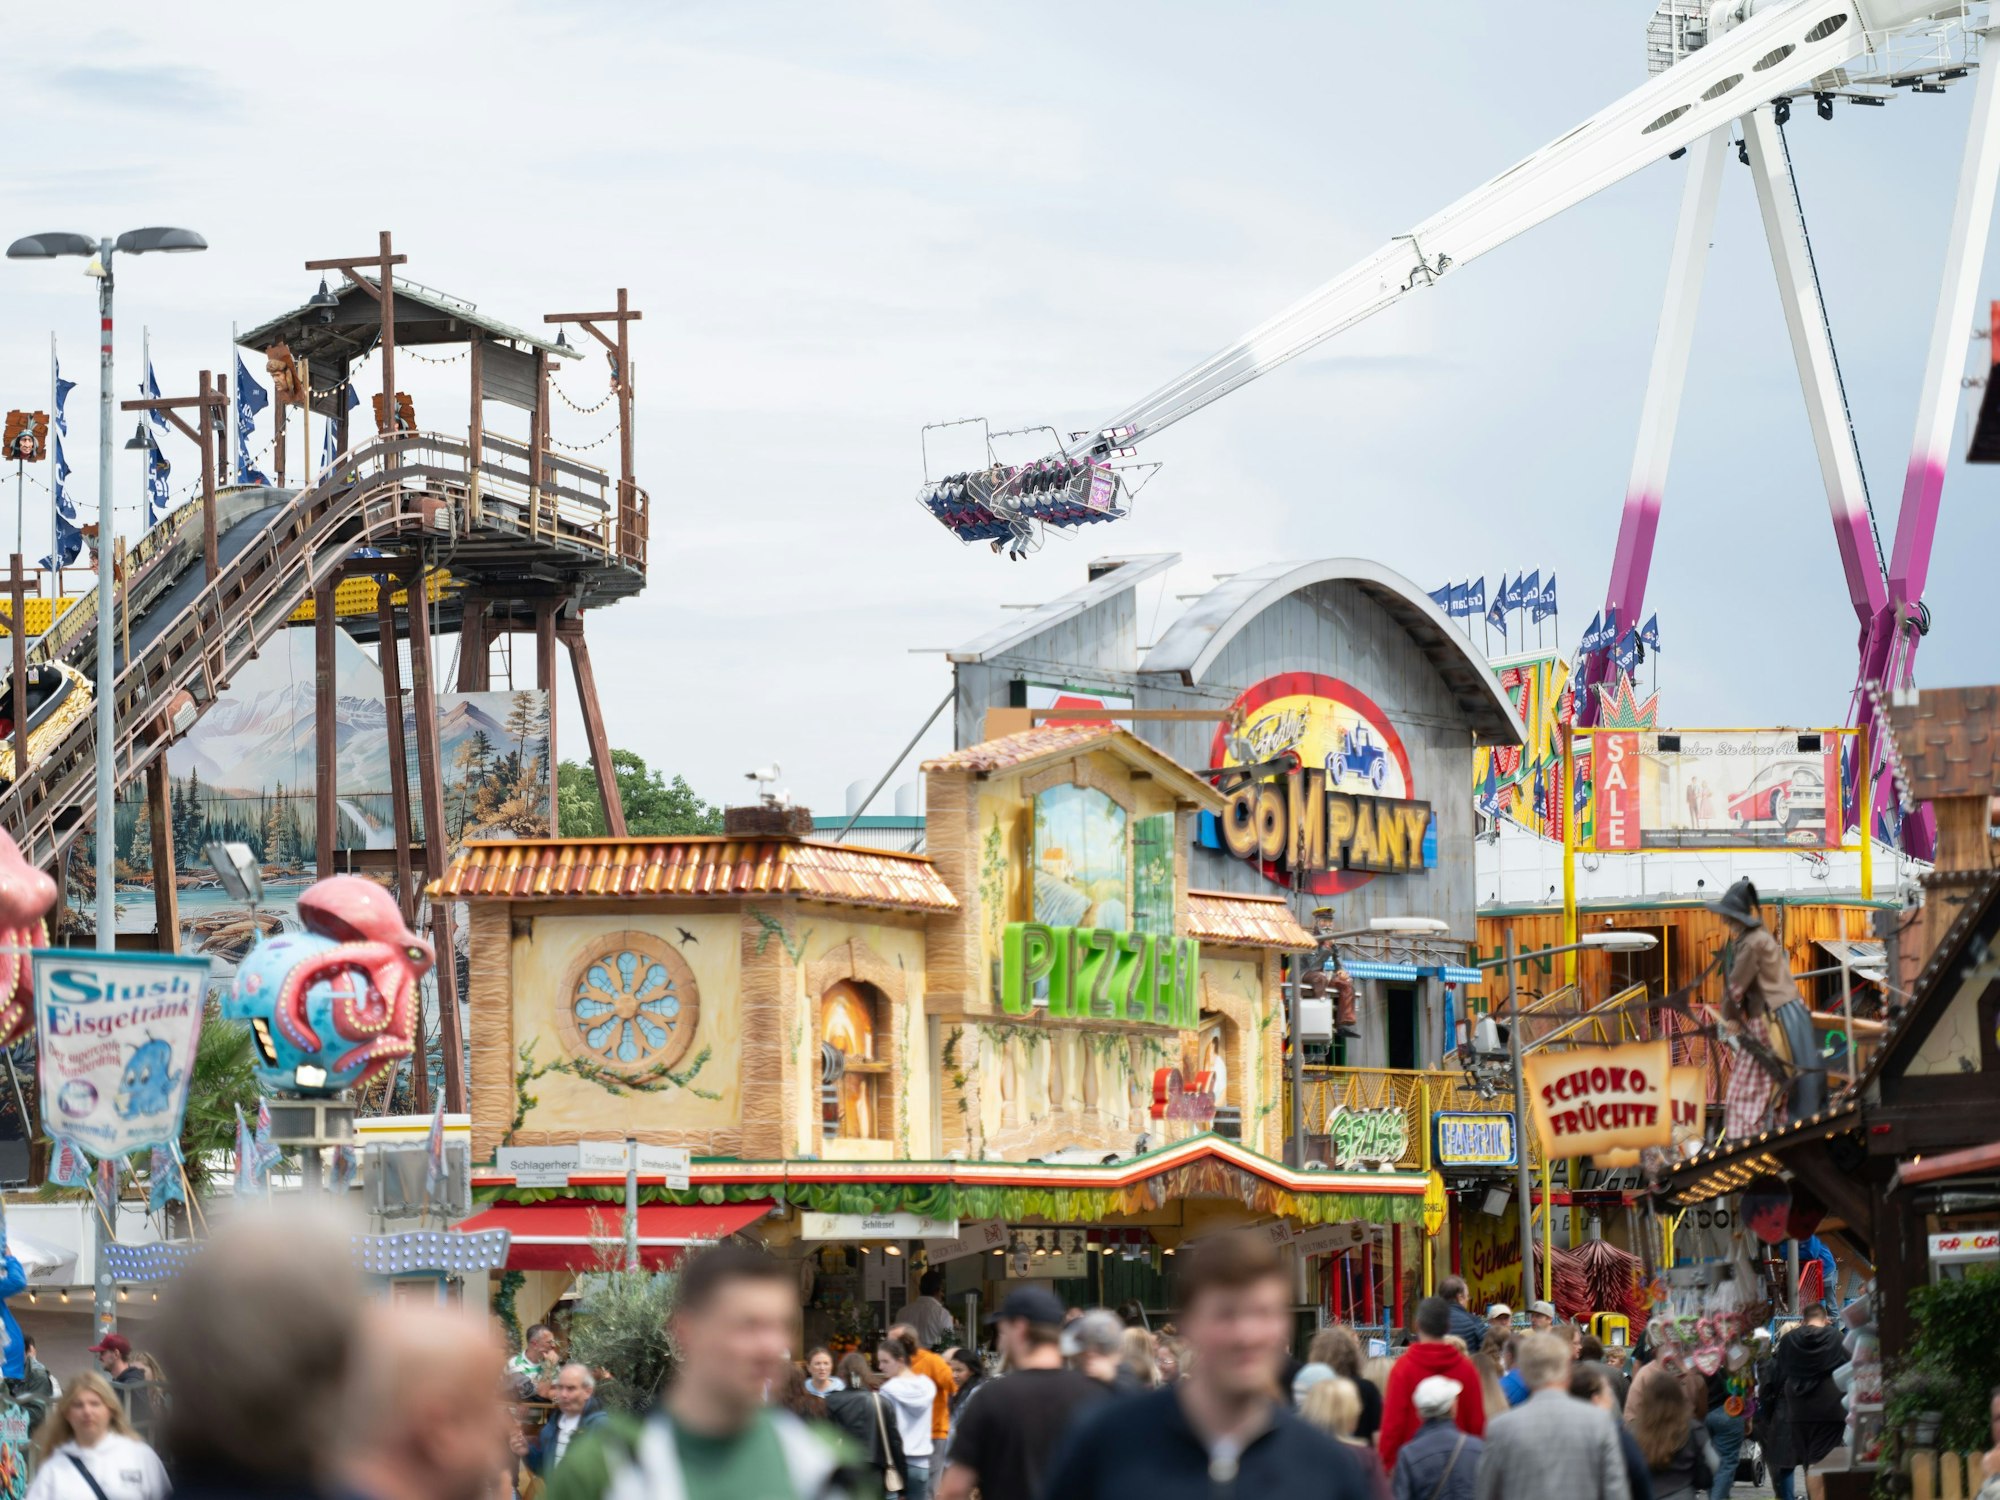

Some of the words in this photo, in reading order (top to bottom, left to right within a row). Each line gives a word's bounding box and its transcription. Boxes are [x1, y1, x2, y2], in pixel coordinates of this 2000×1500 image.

[1603, 735, 1628, 847] SALE
[49, 968, 190, 1004] Slush
[46, 998, 188, 1038] Eisgetränk
[1541, 1066, 1657, 1108] SCHOKO-
[1549, 1100, 1659, 1137] FRÜCHTE
[510, 1159, 578, 1171] Schlagerherz
[861, 1219, 895, 1230] Schlüssel
